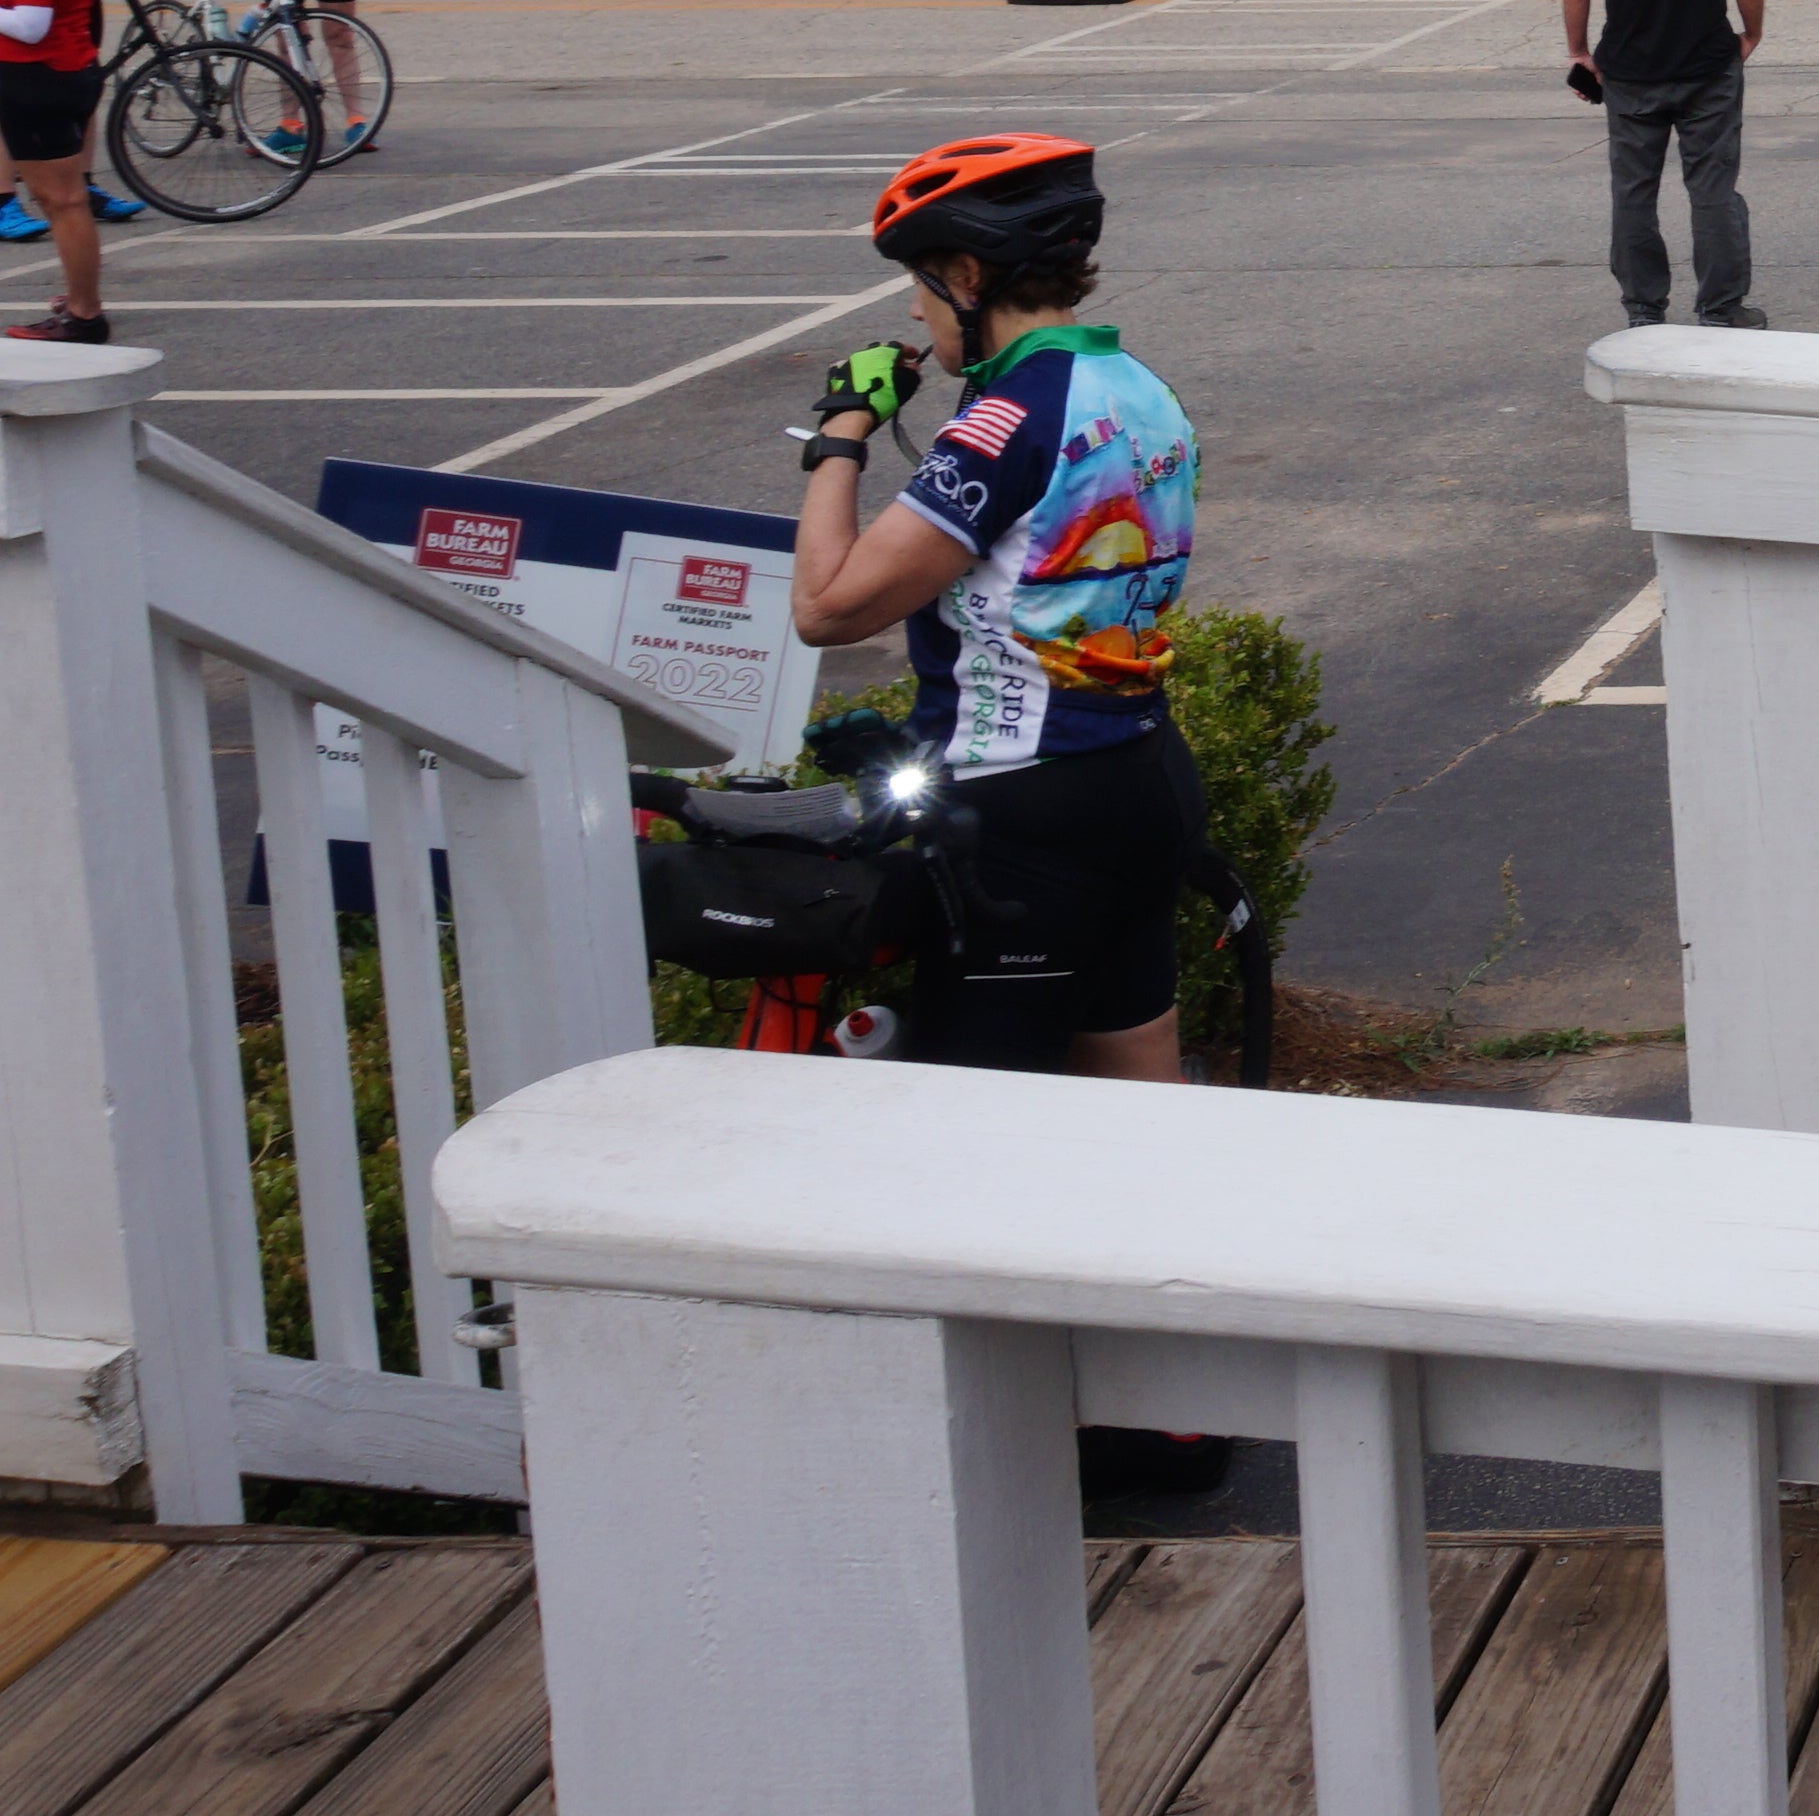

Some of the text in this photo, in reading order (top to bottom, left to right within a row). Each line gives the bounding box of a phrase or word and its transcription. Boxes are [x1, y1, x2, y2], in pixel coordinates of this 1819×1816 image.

[453, 519, 510, 540] FARM
[425, 532, 510, 556] BUREAU
[684, 573, 743, 591] BUREAU
[703, 564, 743, 580] FARM
[662, 603, 753, 622] CERTIFIED FARM
[678, 615, 733, 630] MARKETS
[631, 635, 771, 662] FARM PASSPORT
[627, 653, 765, 704] 2022
[965, 654, 996, 765] GEORGIA
[997, 674, 1026, 740] RIDE
